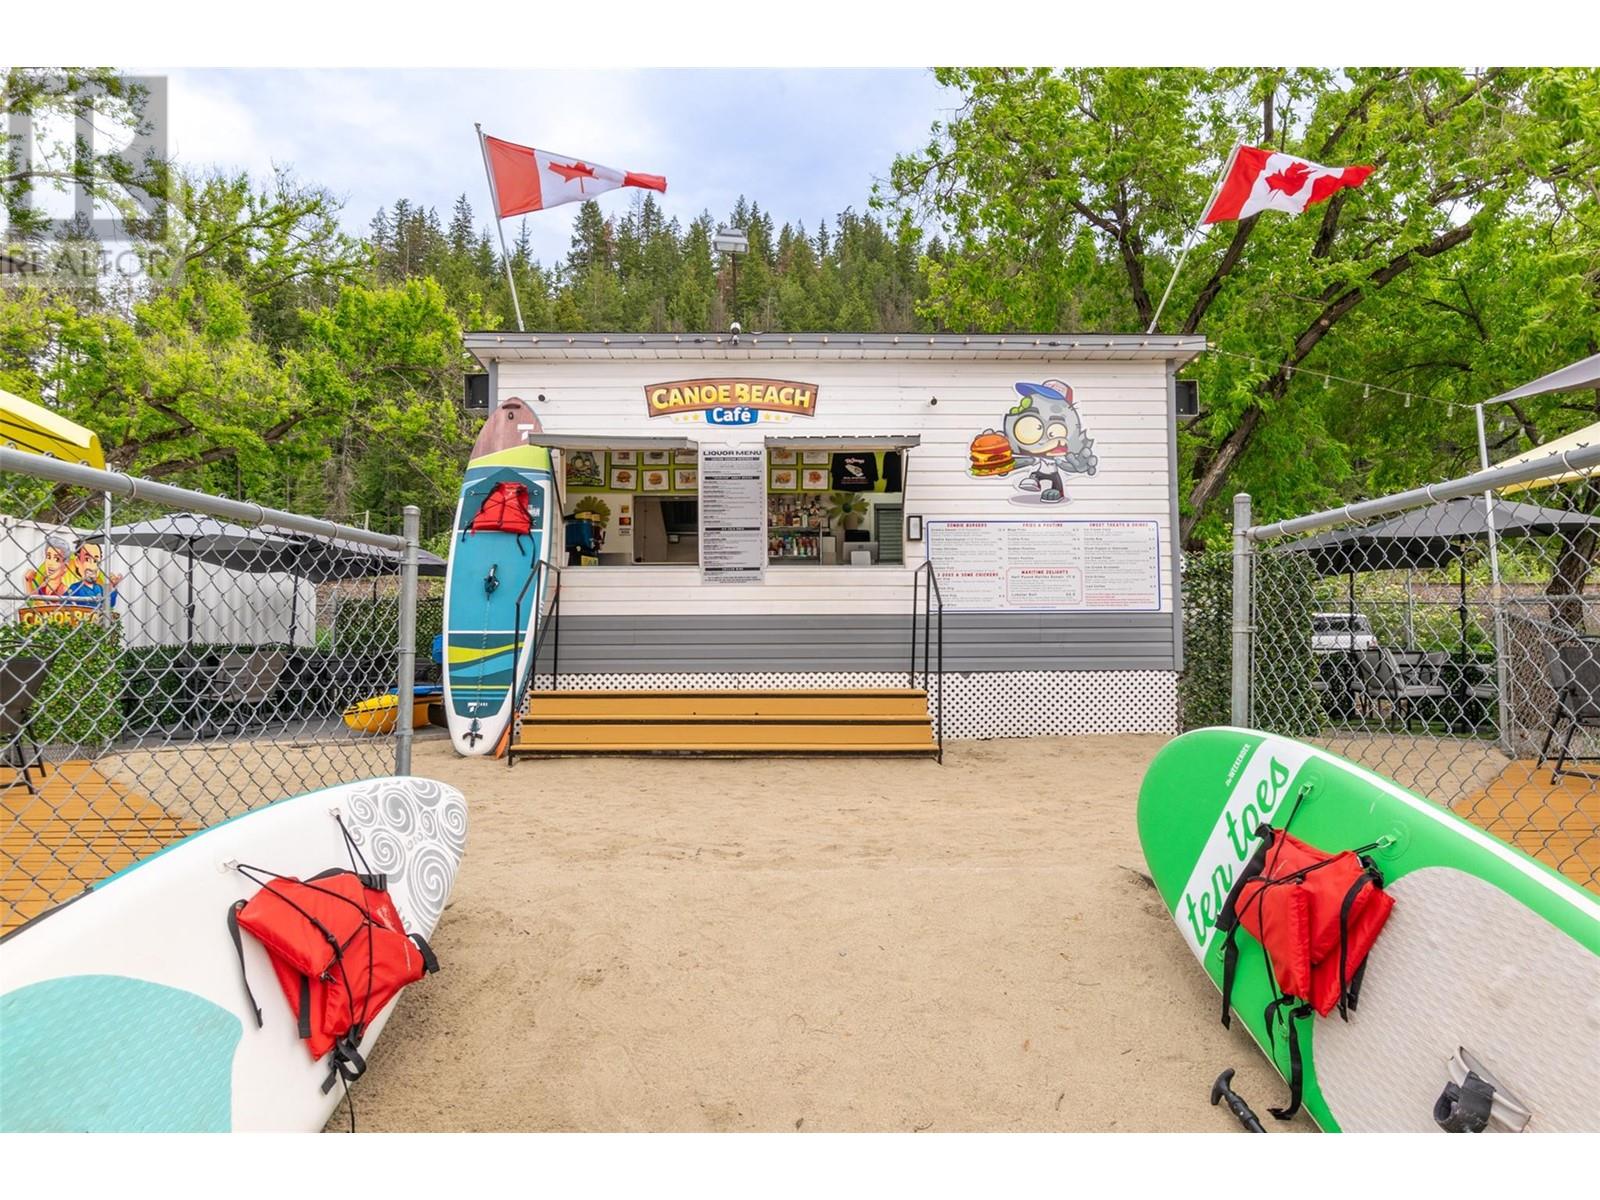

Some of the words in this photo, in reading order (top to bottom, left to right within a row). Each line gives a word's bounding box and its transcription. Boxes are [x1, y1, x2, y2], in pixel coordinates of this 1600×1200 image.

[652, 384, 731, 410] CANOE
[734, 383, 811, 409] BEACH
[712, 406, 751, 423] Café
[1186, 863, 1234, 948] ten
[1226, 756, 1290, 862] toes
